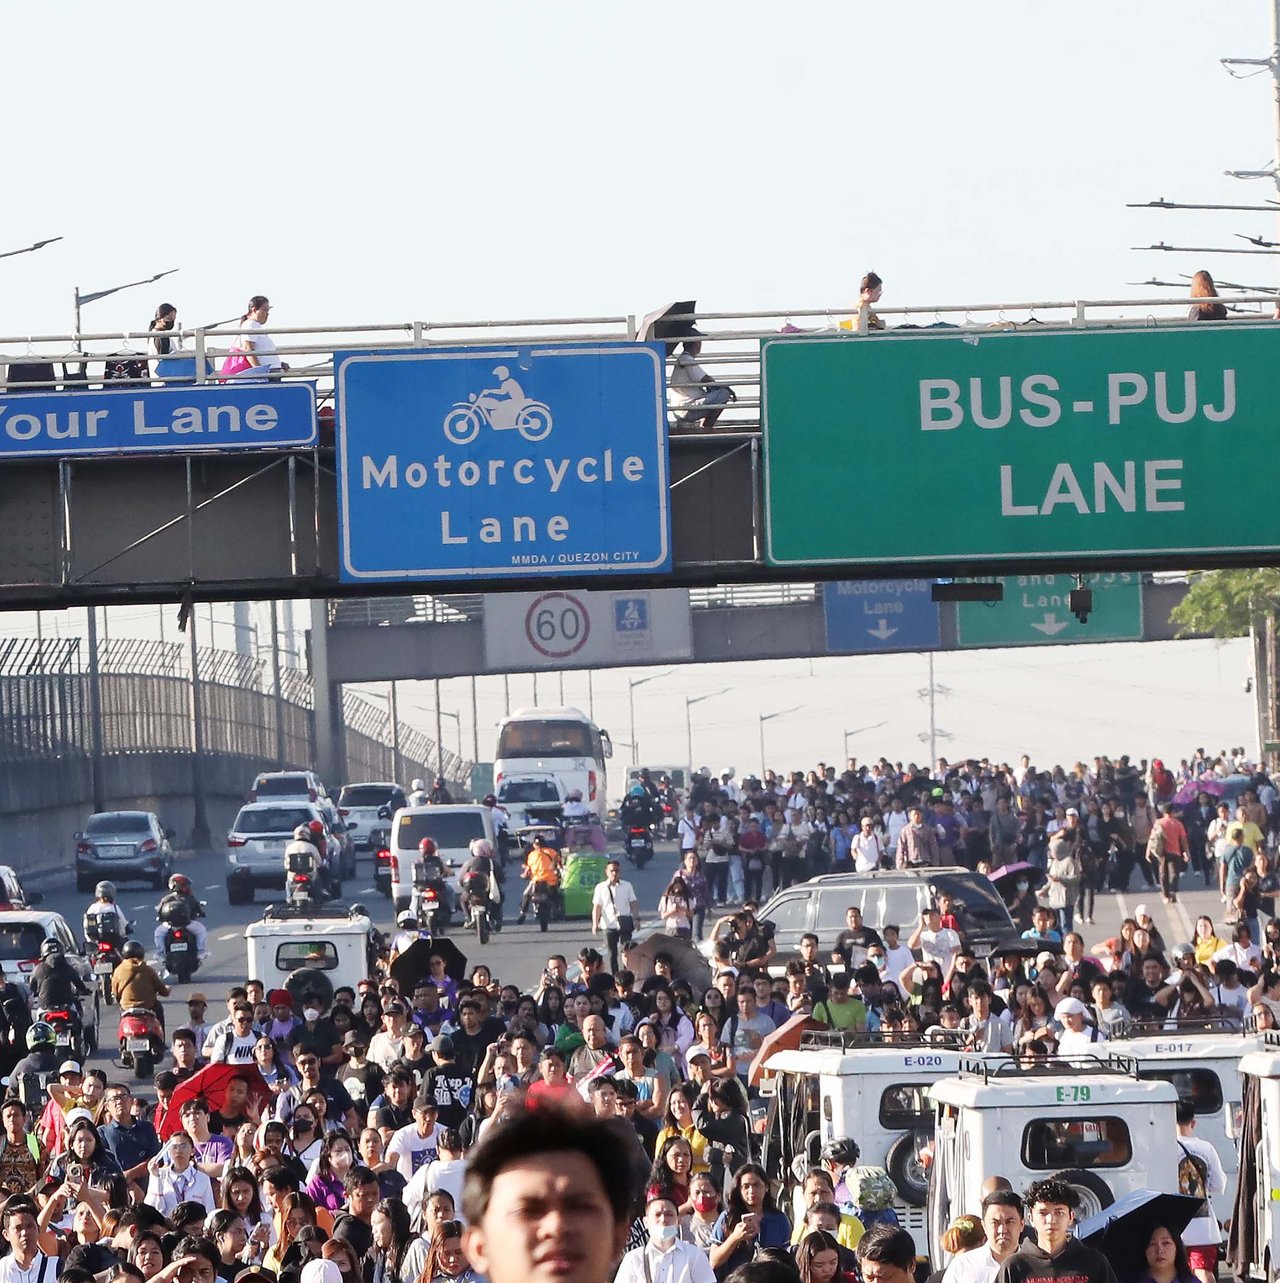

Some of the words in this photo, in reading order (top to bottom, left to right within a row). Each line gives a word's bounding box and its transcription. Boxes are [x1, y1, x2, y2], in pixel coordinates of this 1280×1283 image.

[133, 400, 280, 435] Lane
[362, 449, 644, 492] Motorcycle
[1000, 459, 1185, 517] LANE
[441, 511, 569, 544] Lane
[511, 554, 548, 564] MMDA
[558, 552, 609, 563] QUEZON
[613, 551, 640, 561] CITY
[863, 600, 905, 614] Lane
[536, 608, 579, 641] 60
[235, 1045, 255, 1058] NIK
[1155, 1043, 1194, 1054] E-017
[904, 1056, 942, 1067] E-020
[1056, 1086, 1091, 1102] E-79
